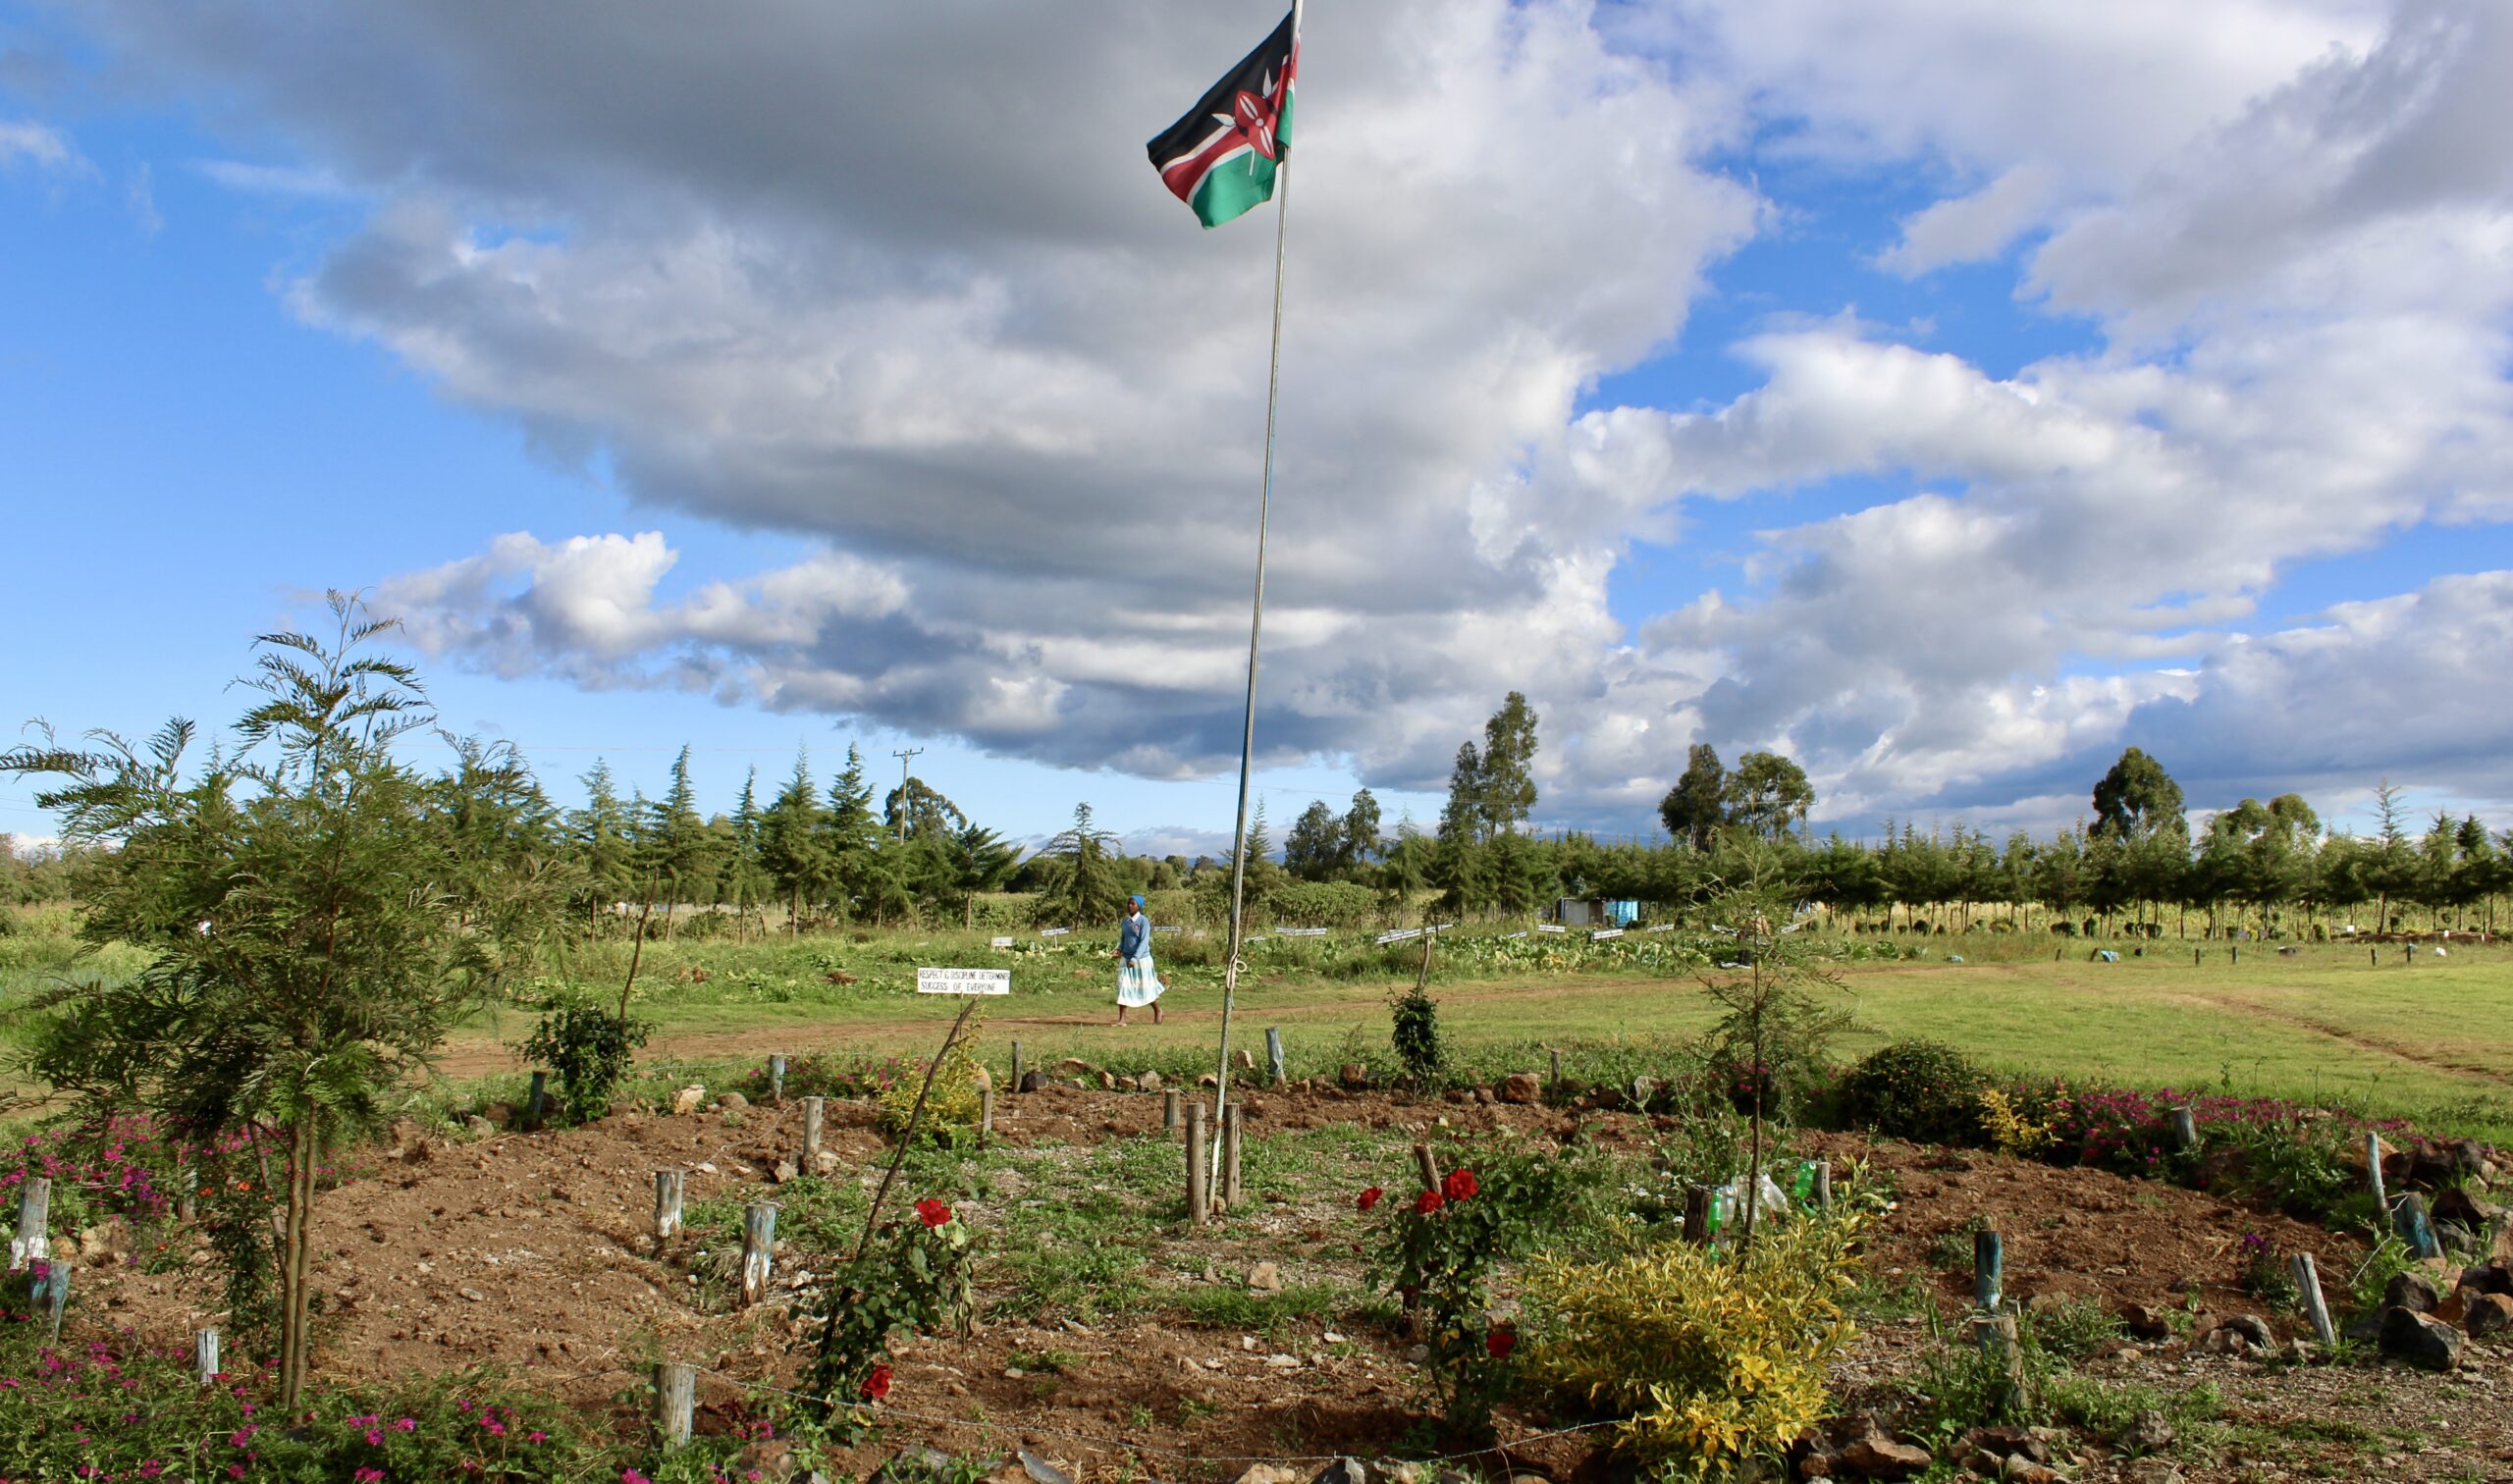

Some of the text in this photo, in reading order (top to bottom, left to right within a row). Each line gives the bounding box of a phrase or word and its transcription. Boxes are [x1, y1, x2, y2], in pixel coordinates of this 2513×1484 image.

[919, 970, 942, 980] RESPECT
[950, 970, 977, 980] DISCIPLINE
[921, 981, 995, 991] SUCCESS OF EVERYONE
